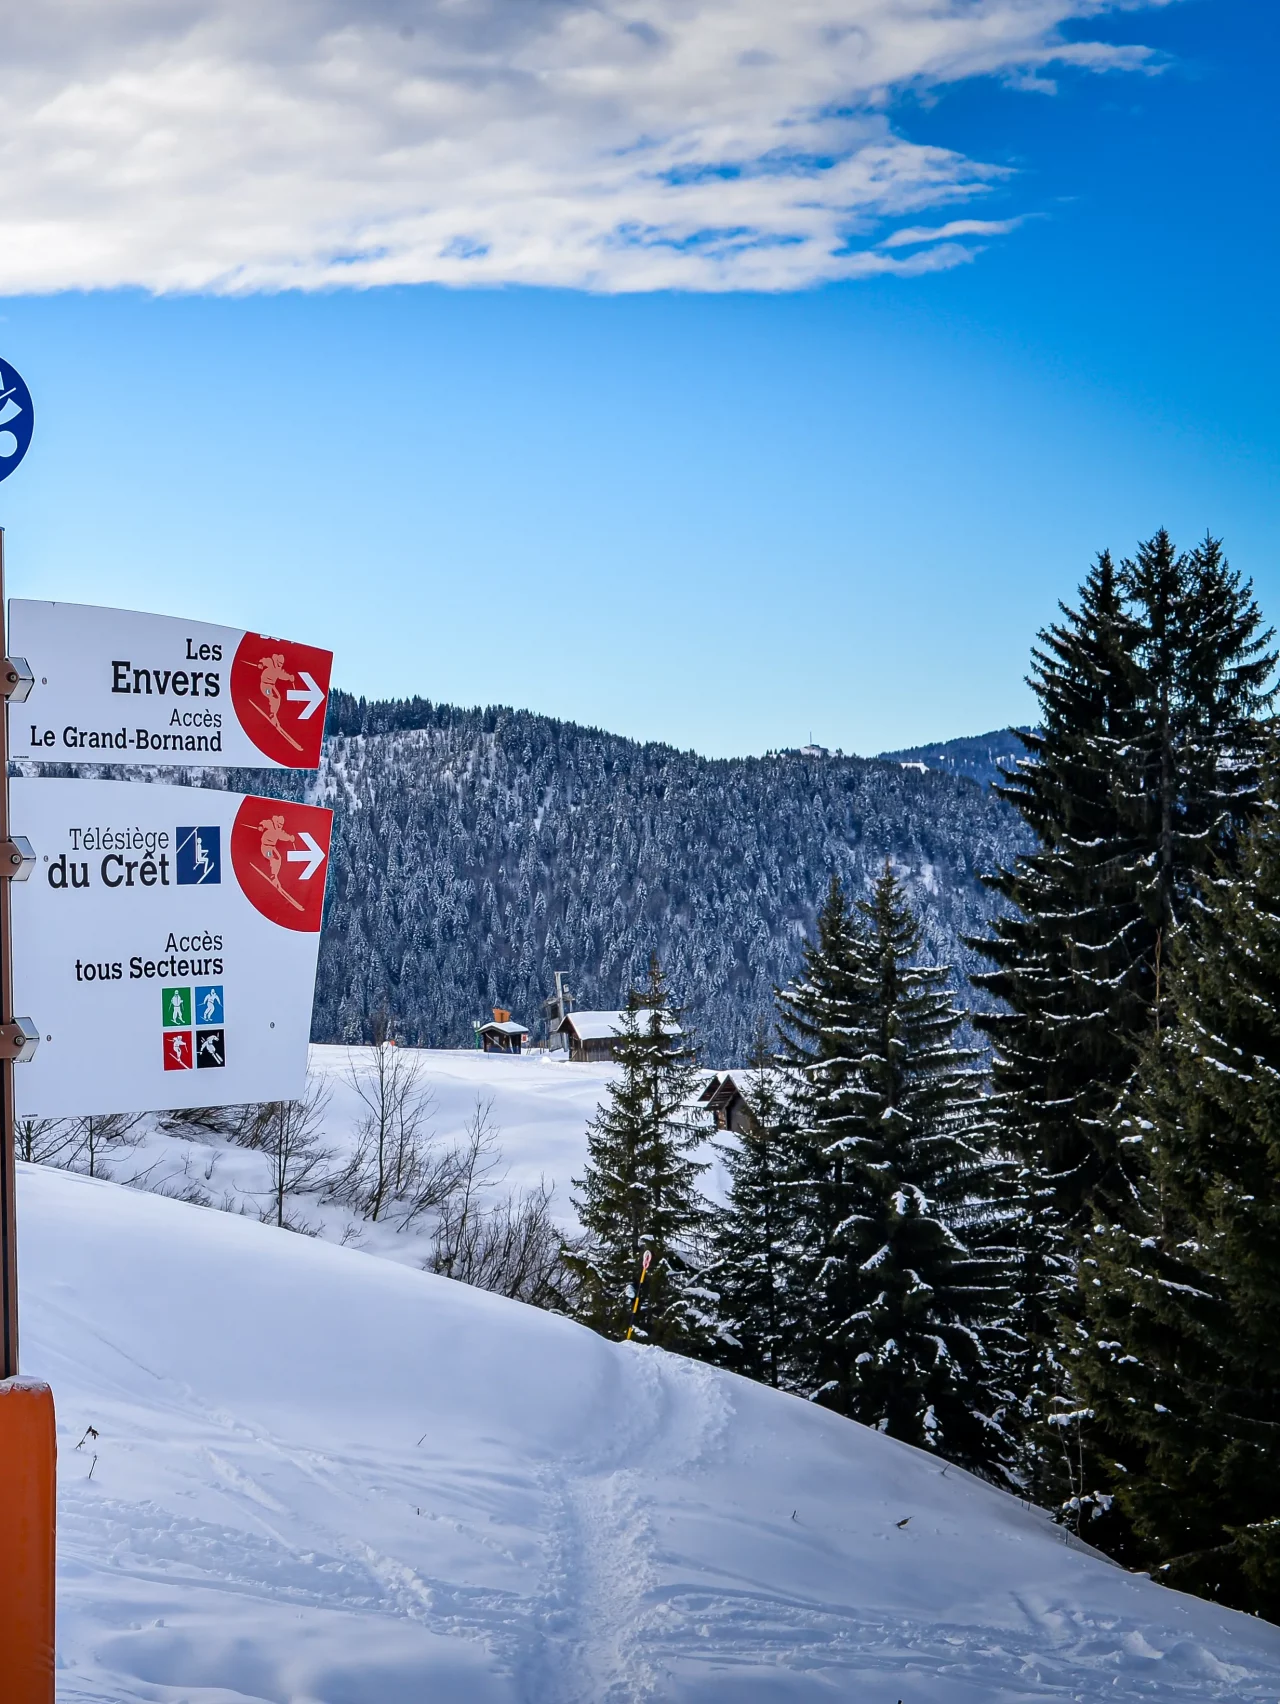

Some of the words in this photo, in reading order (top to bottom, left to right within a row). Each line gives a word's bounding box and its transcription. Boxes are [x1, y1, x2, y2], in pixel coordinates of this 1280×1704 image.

[186, 638, 223, 662] Les
[111, 660, 221, 698] Envers
[169, 708, 222, 728] Accès
[30, 725, 56, 747] Le
[62, 727, 223, 752] Grand-Bornand
[69, 827, 170, 851] Télésiège
[47, 854, 90, 888] du
[100, 850, 170, 888] Crêt
[164, 930, 223, 953] Accès
[75, 958, 122, 982] tous
[129, 955, 224, 979] Secteurs
